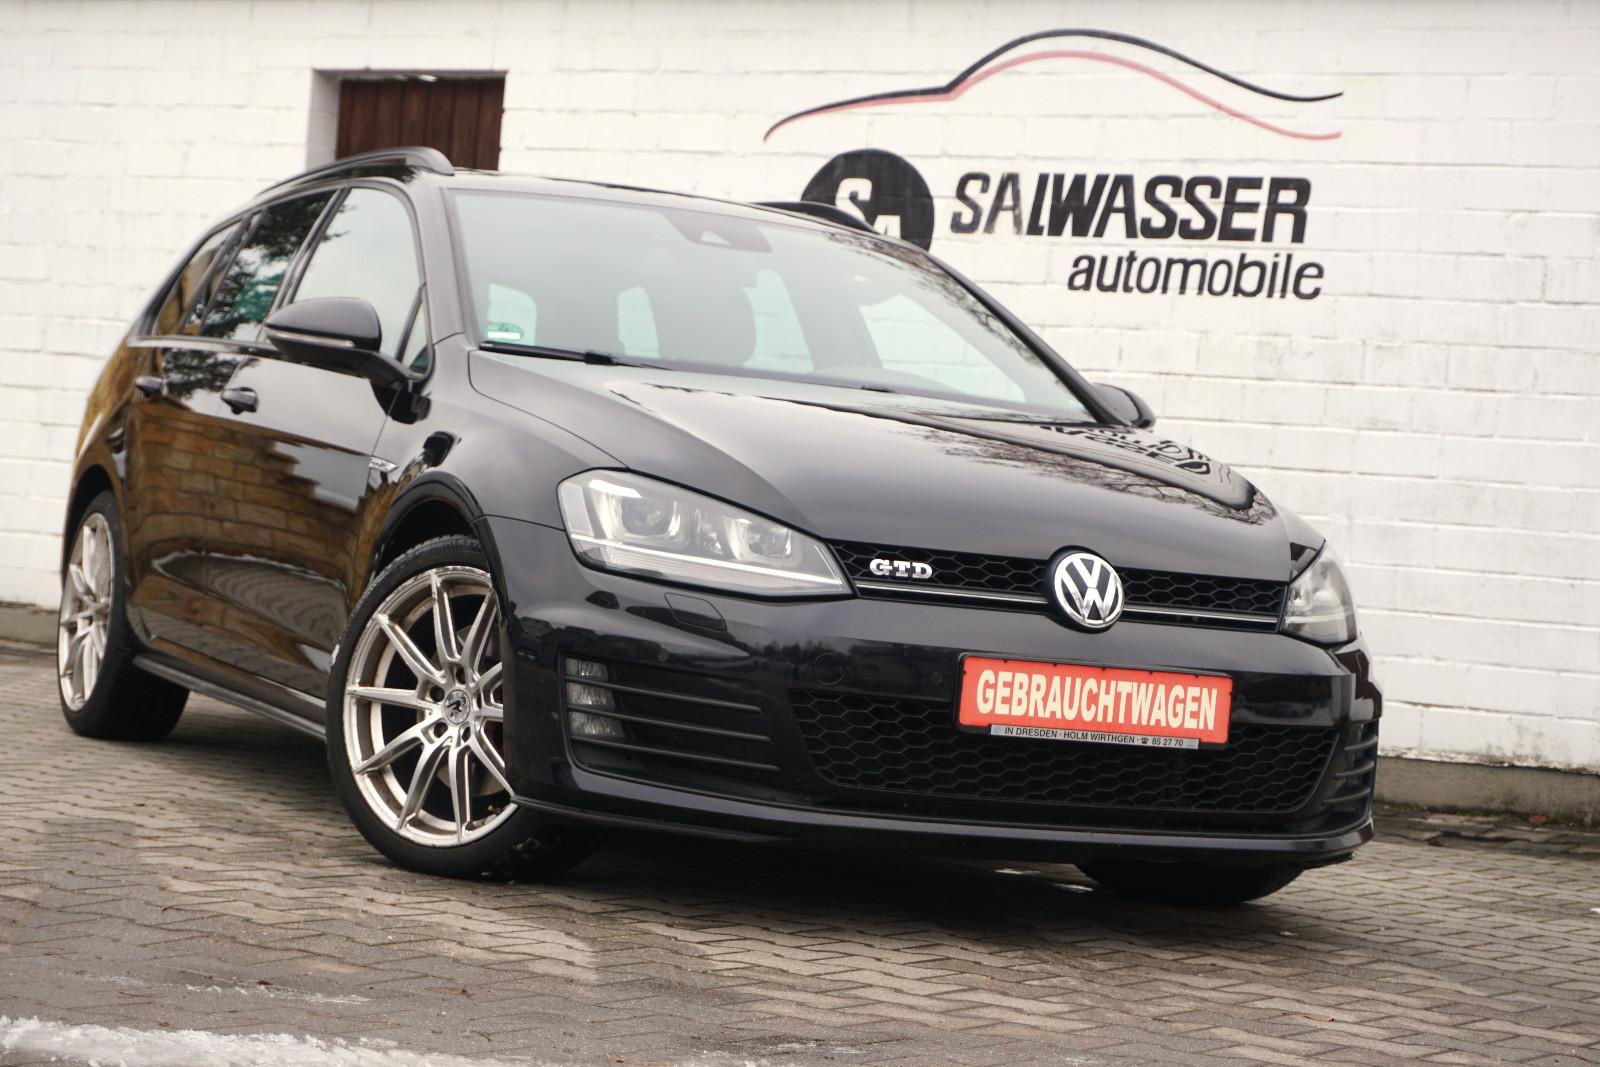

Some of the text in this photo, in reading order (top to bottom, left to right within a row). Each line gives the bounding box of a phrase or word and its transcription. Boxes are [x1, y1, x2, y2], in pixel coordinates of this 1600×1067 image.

[950, 171, 1311, 243] SALWASSER
[1068, 250, 1324, 299] automobile
[869, 558, 933, 580] GTD
[1055, 552, 1124, 628] VW
[976, 669, 1218, 730] GEBRAUCHTWAGEN
[1004, 727, 1184, 747] IN DRESDEN HOLM WIRTHGEN 85 27 70
